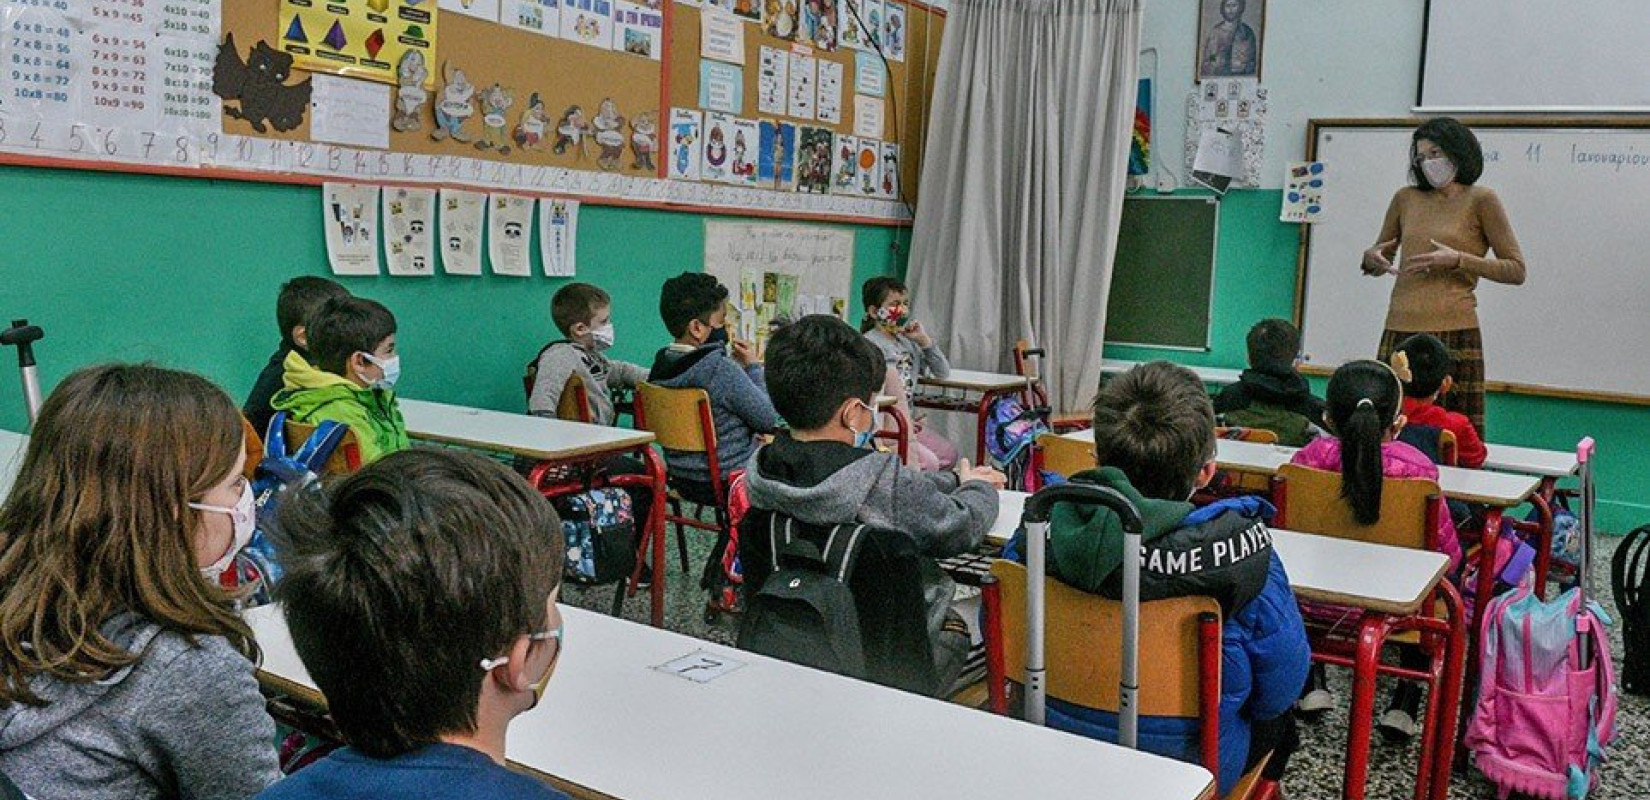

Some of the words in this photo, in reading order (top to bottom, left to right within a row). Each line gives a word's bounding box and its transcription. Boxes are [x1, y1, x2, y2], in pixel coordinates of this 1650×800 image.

[92, 6, 100, 17] 5
[111, 9, 119, 19] 9
[13, 20, 21, 31] 6
[33, 23, 42, 34] 8
[12, 37, 20, 47] 7
[33, 39, 42, 51] 8
[92, 33, 100, 44] 6
[111, 36, 119, 46] 9
[11, 53, 20, 64] 8
[33, 56, 42, 67] 8
[92, 49, 100, 60] 7
[111, 51, 119, 62] 9
[11, 70, 20, 81] 9
[33, 72, 42, 84] 8
[110, 67, 119, 78] 9
[91, 80, 100, 91] 9
[110, 81, 119, 92] 9
[30, 121, 46, 149] 4
[69, 124, 85, 153] 5
[104, 128, 118, 156] 6
[140, 131, 156, 159] 7
[175, 135, 188, 163] 8
[206, 131, 219, 160] 9
[236, 136, 253, 162] 10
[1525, 142, 1542, 164] 11
[678, 657, 724, 673] 7
